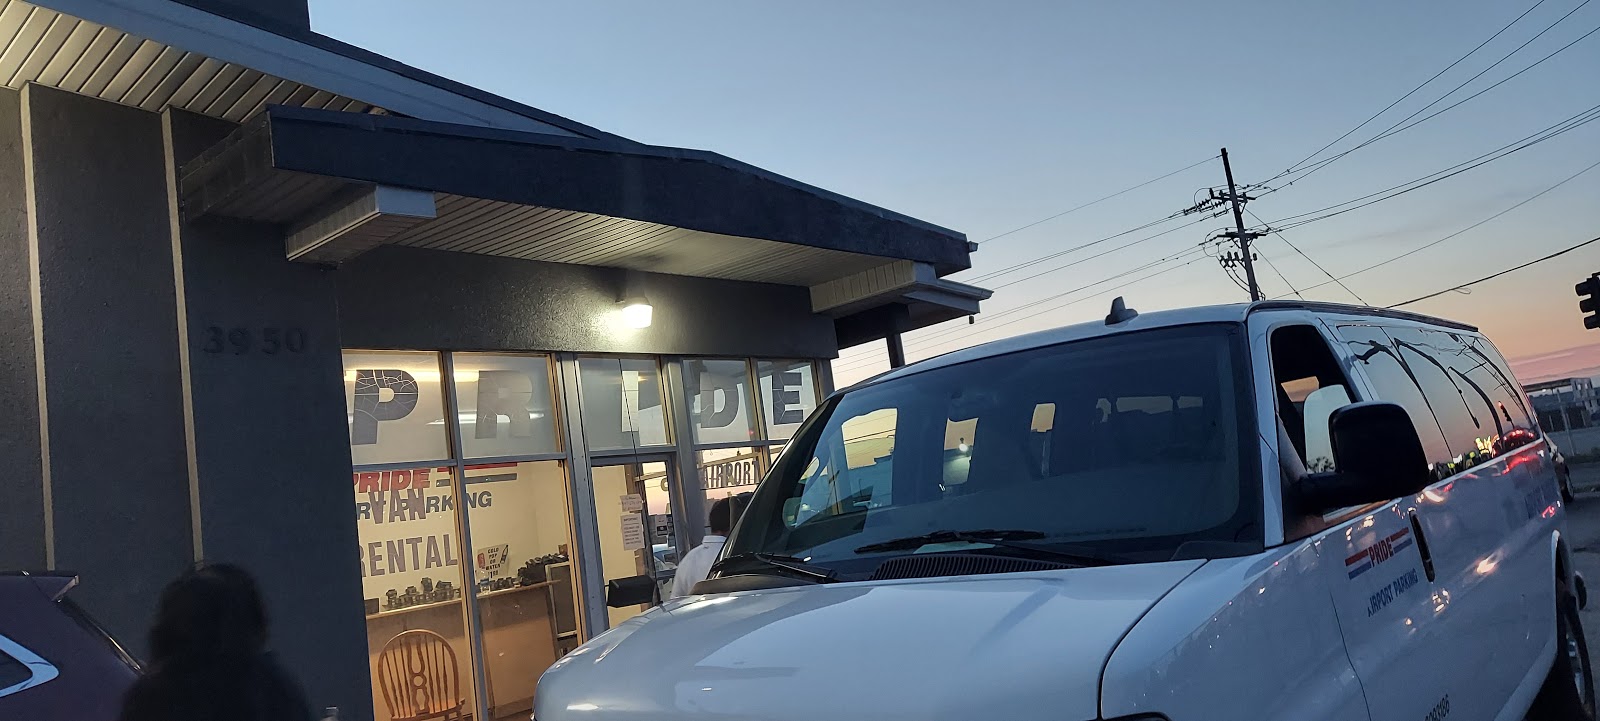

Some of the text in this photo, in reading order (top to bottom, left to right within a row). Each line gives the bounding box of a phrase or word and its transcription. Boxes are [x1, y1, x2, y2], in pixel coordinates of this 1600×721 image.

[351, 368, 804, 445] PRIDE
[702, 459, 761, 489] AIRPORT
[368, 488, 426, 524] VAN
[1368, 536, 1394, 567] PRIDE
[1367, 567, 1419, 618] AIRPORT PARKING
